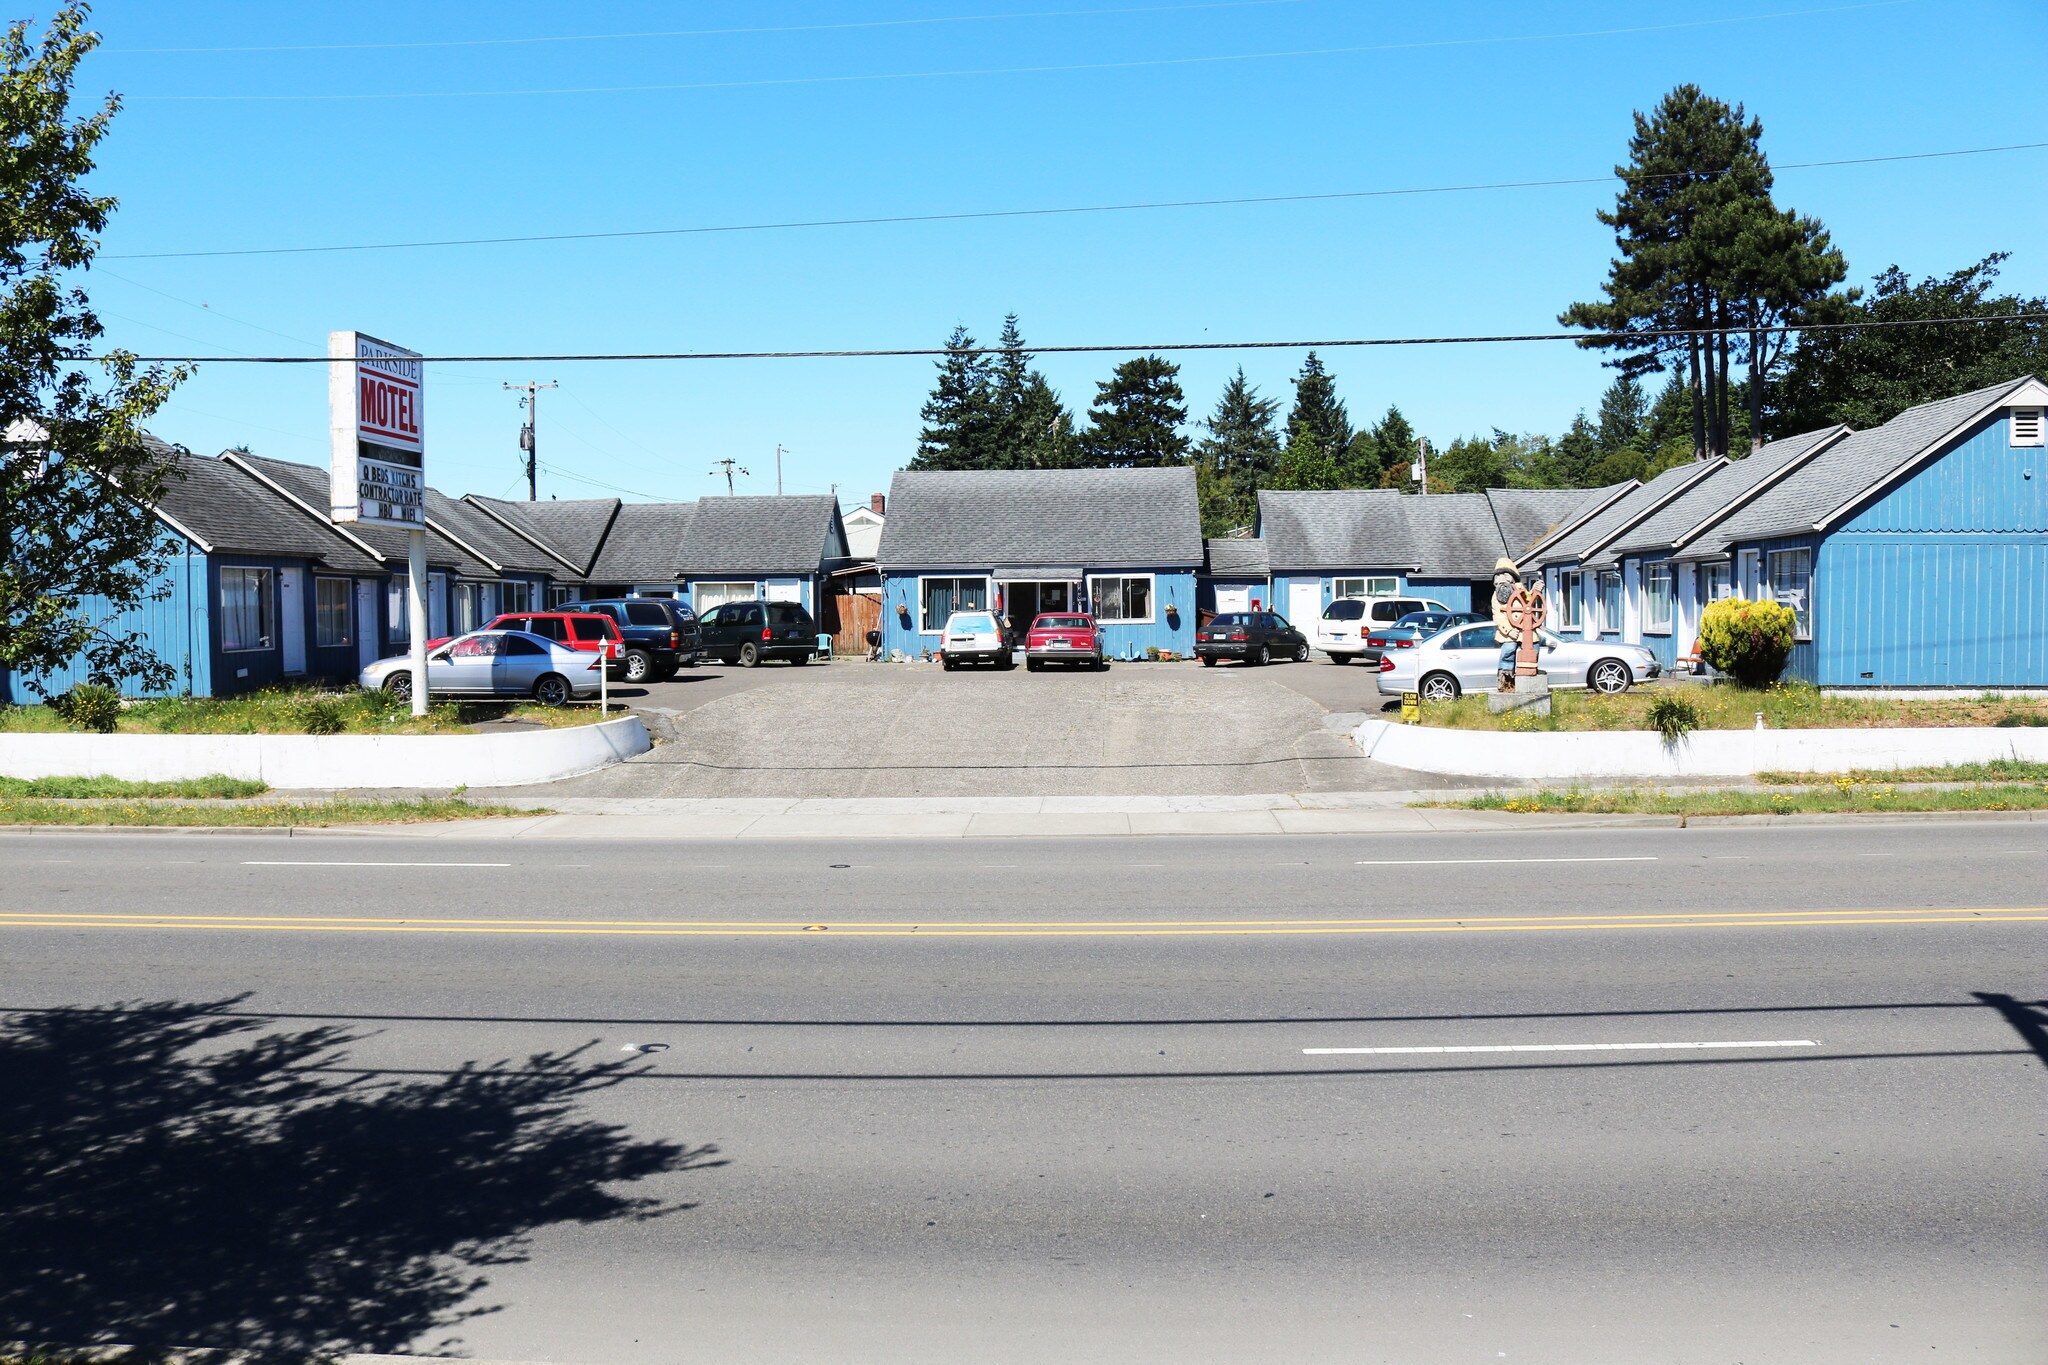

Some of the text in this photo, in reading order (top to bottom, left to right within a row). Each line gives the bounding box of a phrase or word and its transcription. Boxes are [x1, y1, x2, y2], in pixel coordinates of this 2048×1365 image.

[361, 344, 417, 380] PARKSIDE
[361, 377, 418, 434] MOTEL
[371, 466, 388, 483] BEDS
[359, 483, 422, 506] CONTRACTOR RATE
[379, 503, 393, 518] HBO
[401, 505, 416, 521] WIFI
